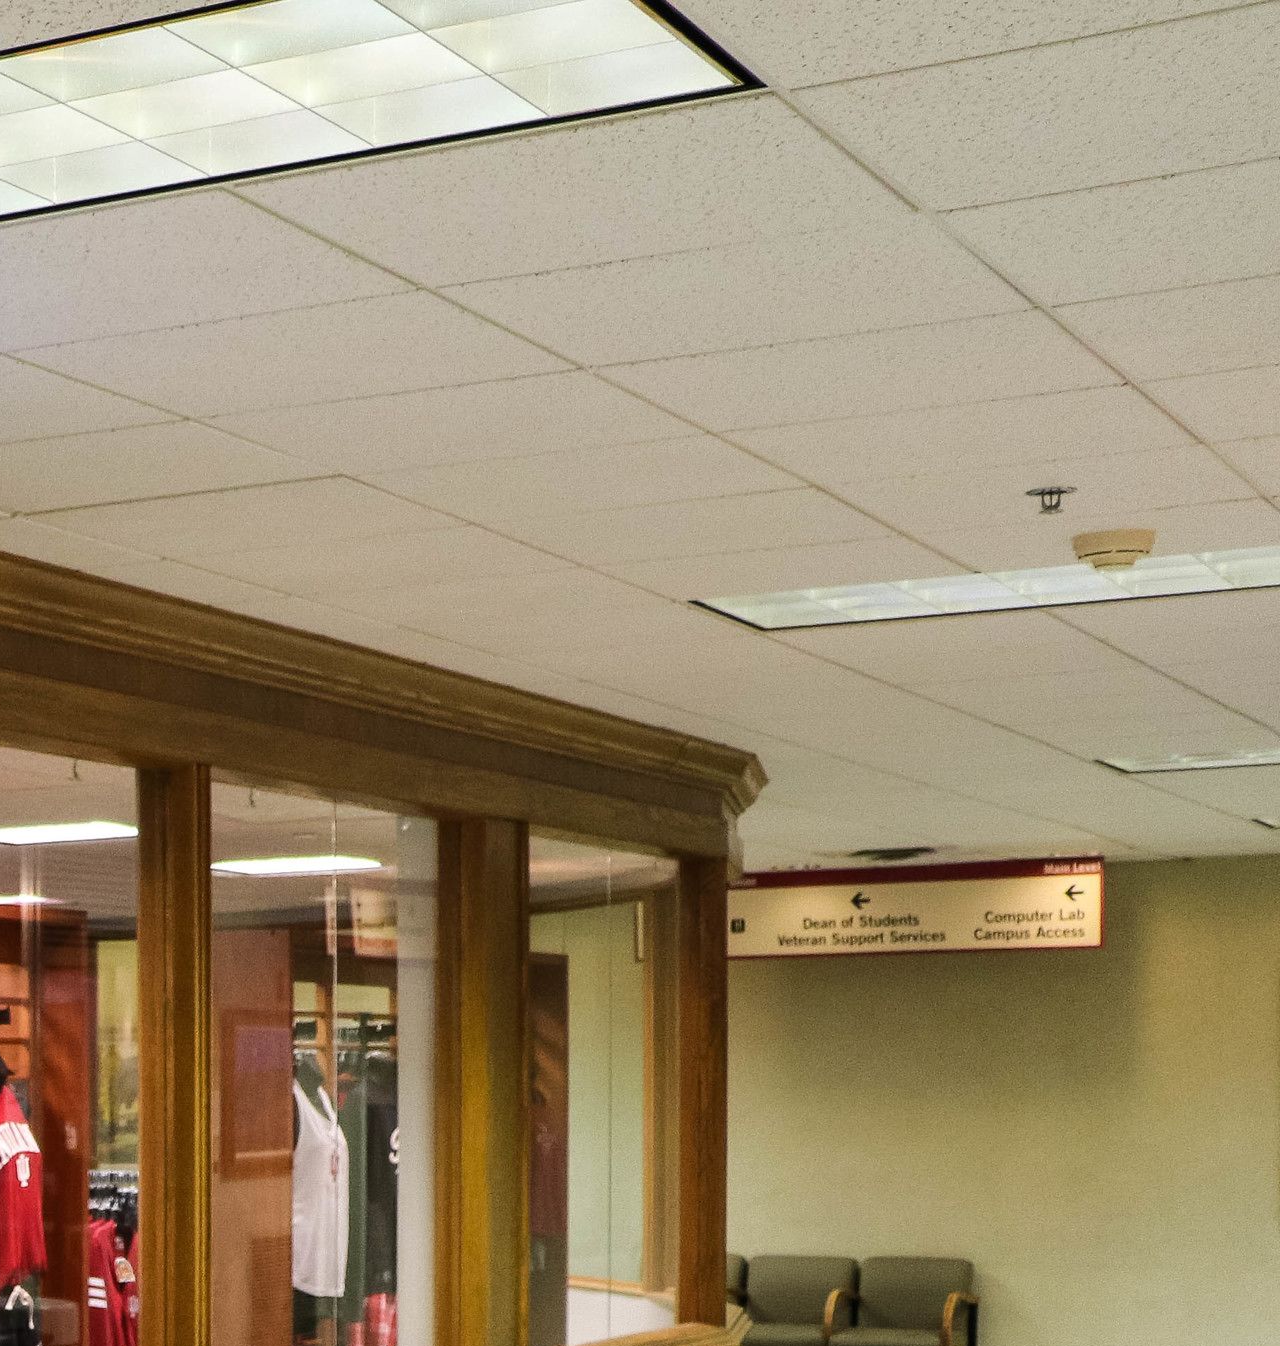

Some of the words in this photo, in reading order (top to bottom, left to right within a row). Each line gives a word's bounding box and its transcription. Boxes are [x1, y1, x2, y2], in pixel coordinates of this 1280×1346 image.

[803, 918, 836, 930] Dean
[841, 916, 854, 927] of
[859, 913, 920, 928] Students
[984, 910, 1052, 924] Computer
[1059, 909, 1085, 921] Lab
[778, 933, 827, 946] Veteran
[832, 932, 884, 947] Support
[890, 930, 945, 944] Services
[974, 928, 1031, 941] Campus
[1036, 926, 1085, 939] Access
